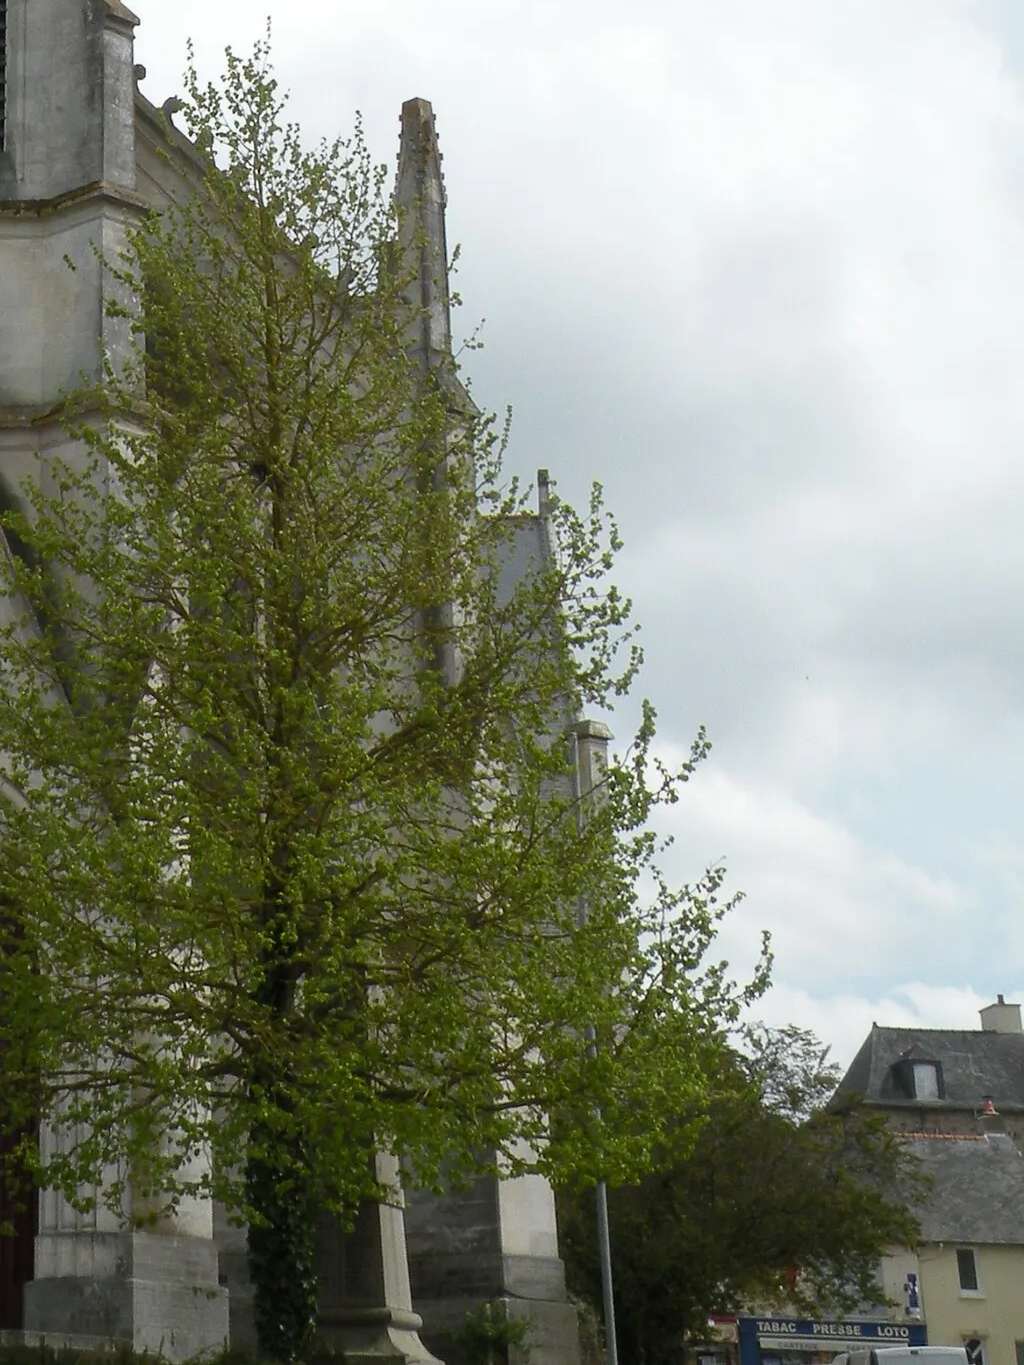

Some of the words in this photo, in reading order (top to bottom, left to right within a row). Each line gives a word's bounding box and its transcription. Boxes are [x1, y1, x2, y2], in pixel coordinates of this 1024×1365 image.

[756, 1321, 797, 1333] TABAC
[813, 1324, 862, 1336] PRESSE
[877, 1326, 909, 1337] LOTO
